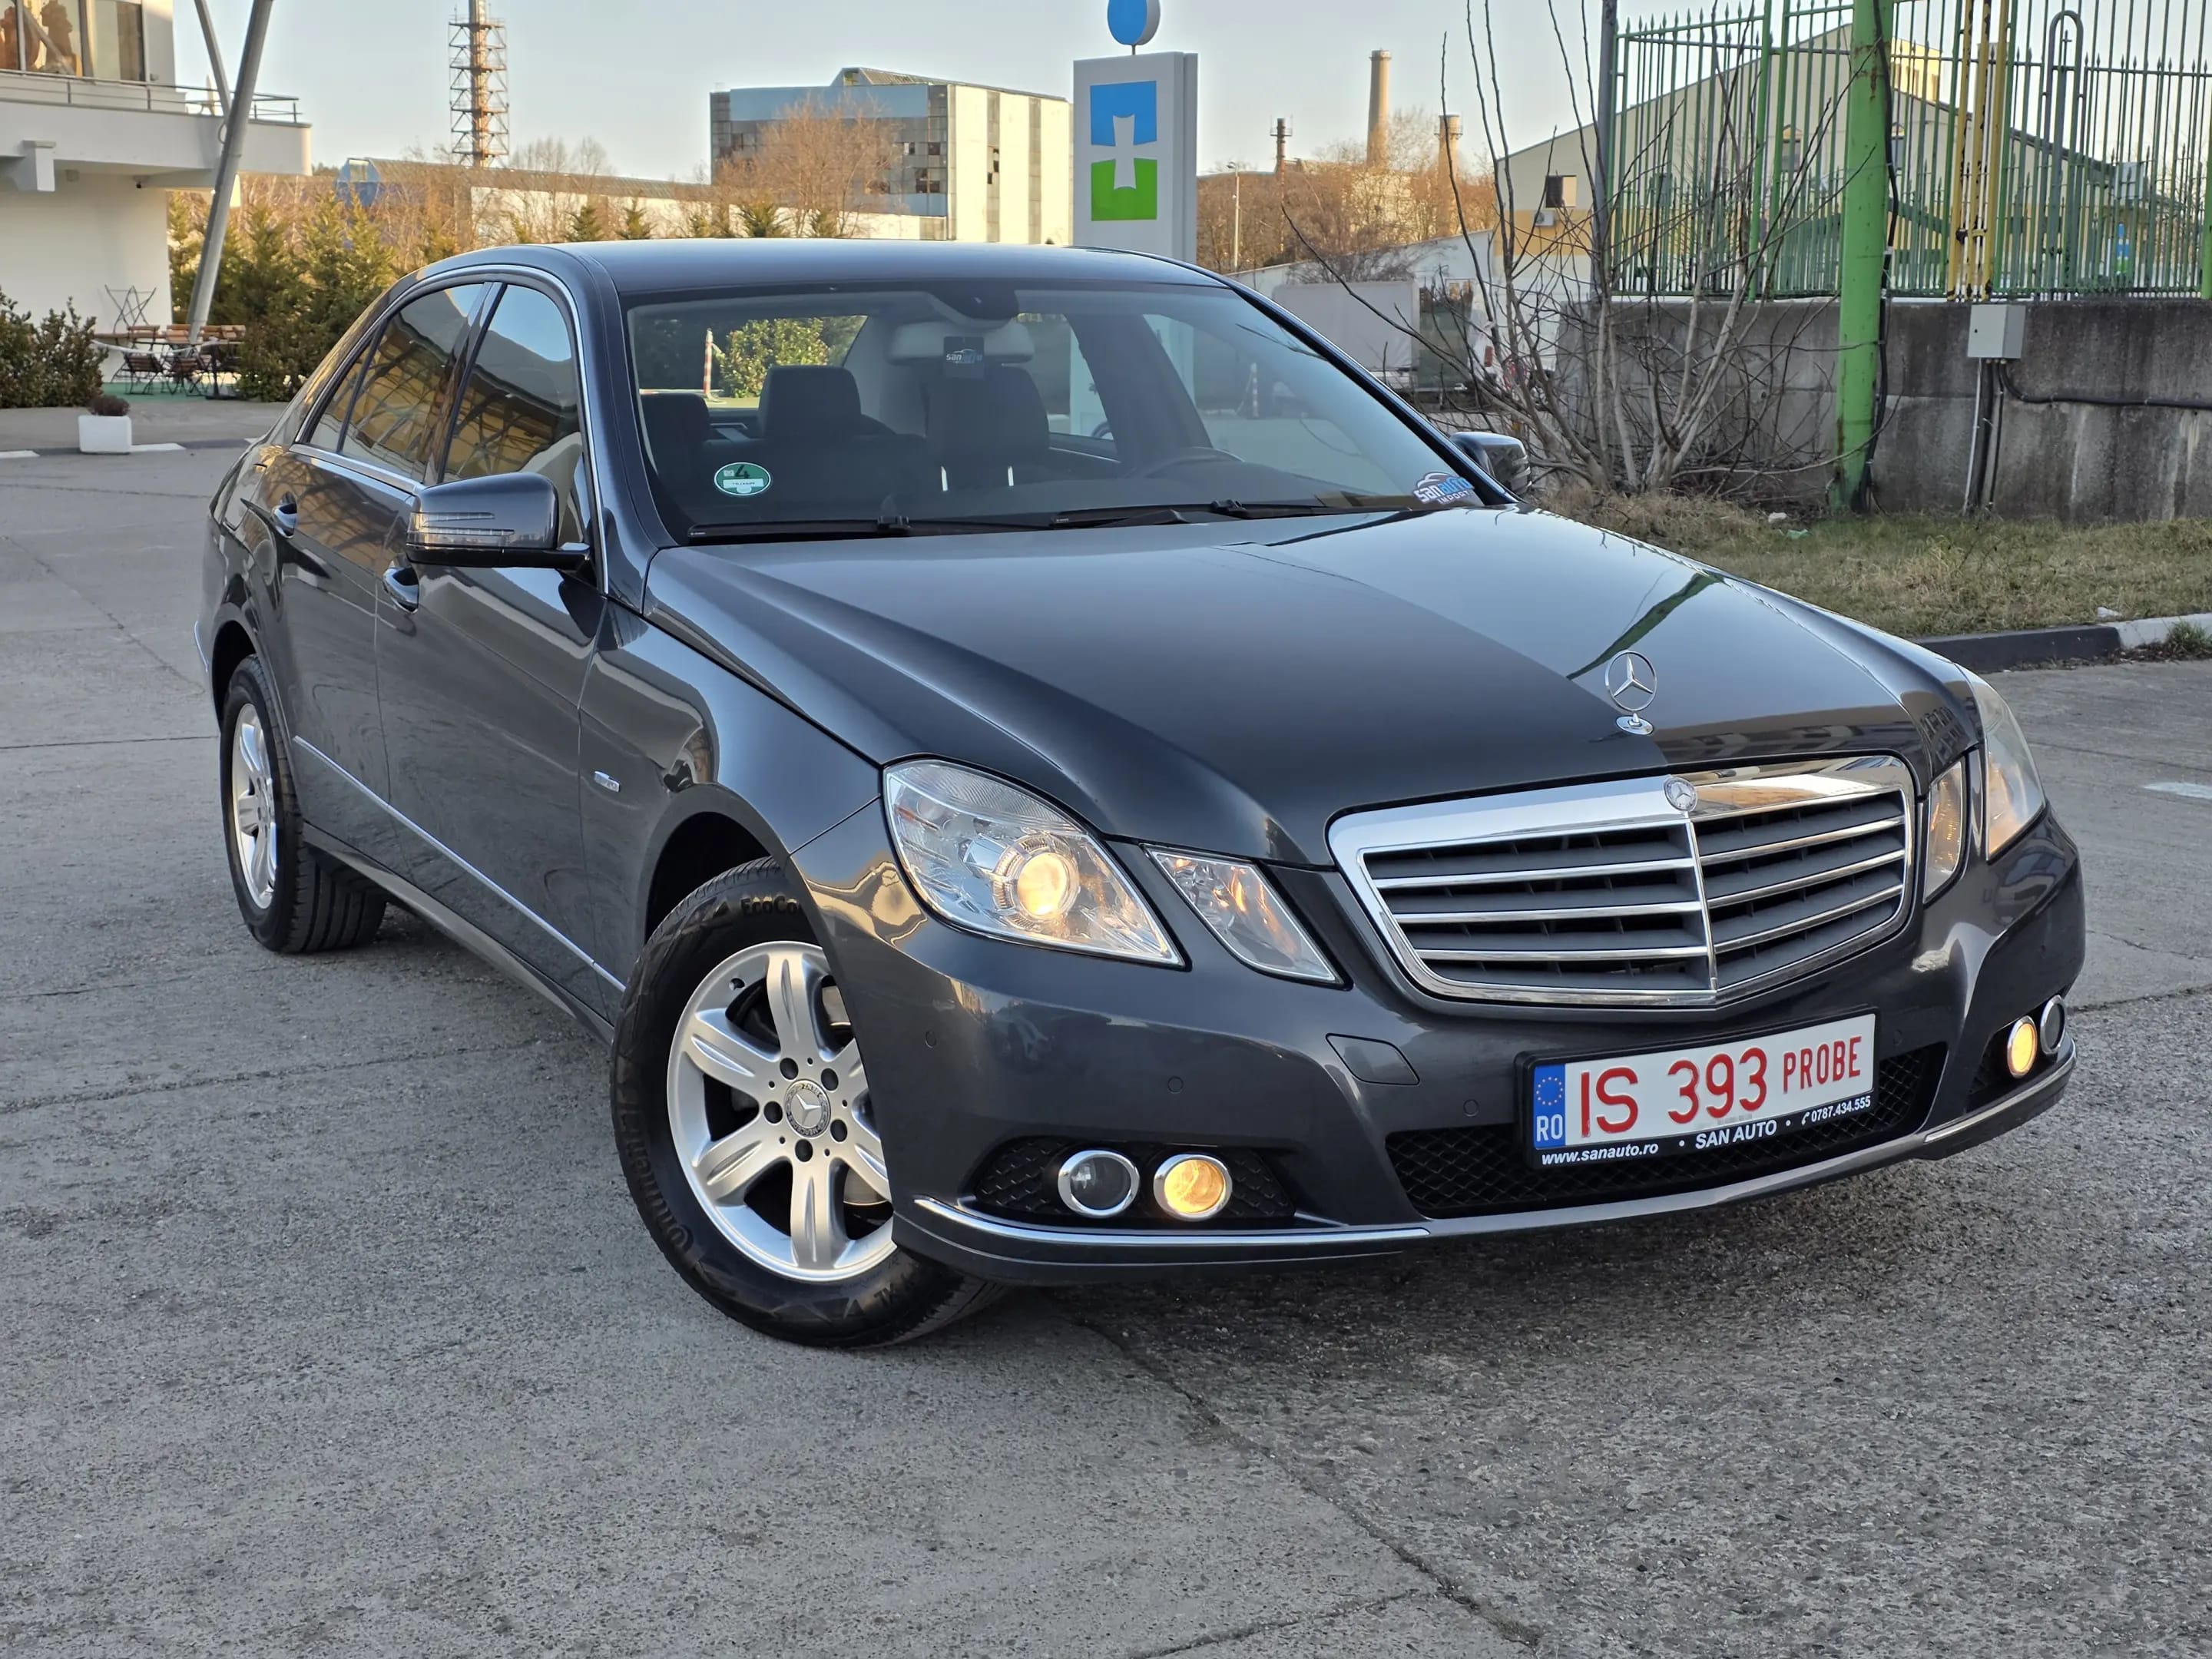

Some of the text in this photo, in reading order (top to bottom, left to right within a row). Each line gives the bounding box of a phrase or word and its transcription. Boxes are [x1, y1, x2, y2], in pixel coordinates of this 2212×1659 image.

[735, 465, 750, 479] 4
[1437, 490, 1470, 504] IMPORT
[1581, 1036, 1862, 1138] IS 393 PROBE
[1536, 1114, 1564, 1142] RO
[1542, 1095, 1871, 1165] www.sanauto.ro SAN AUTO 0787.434.555
